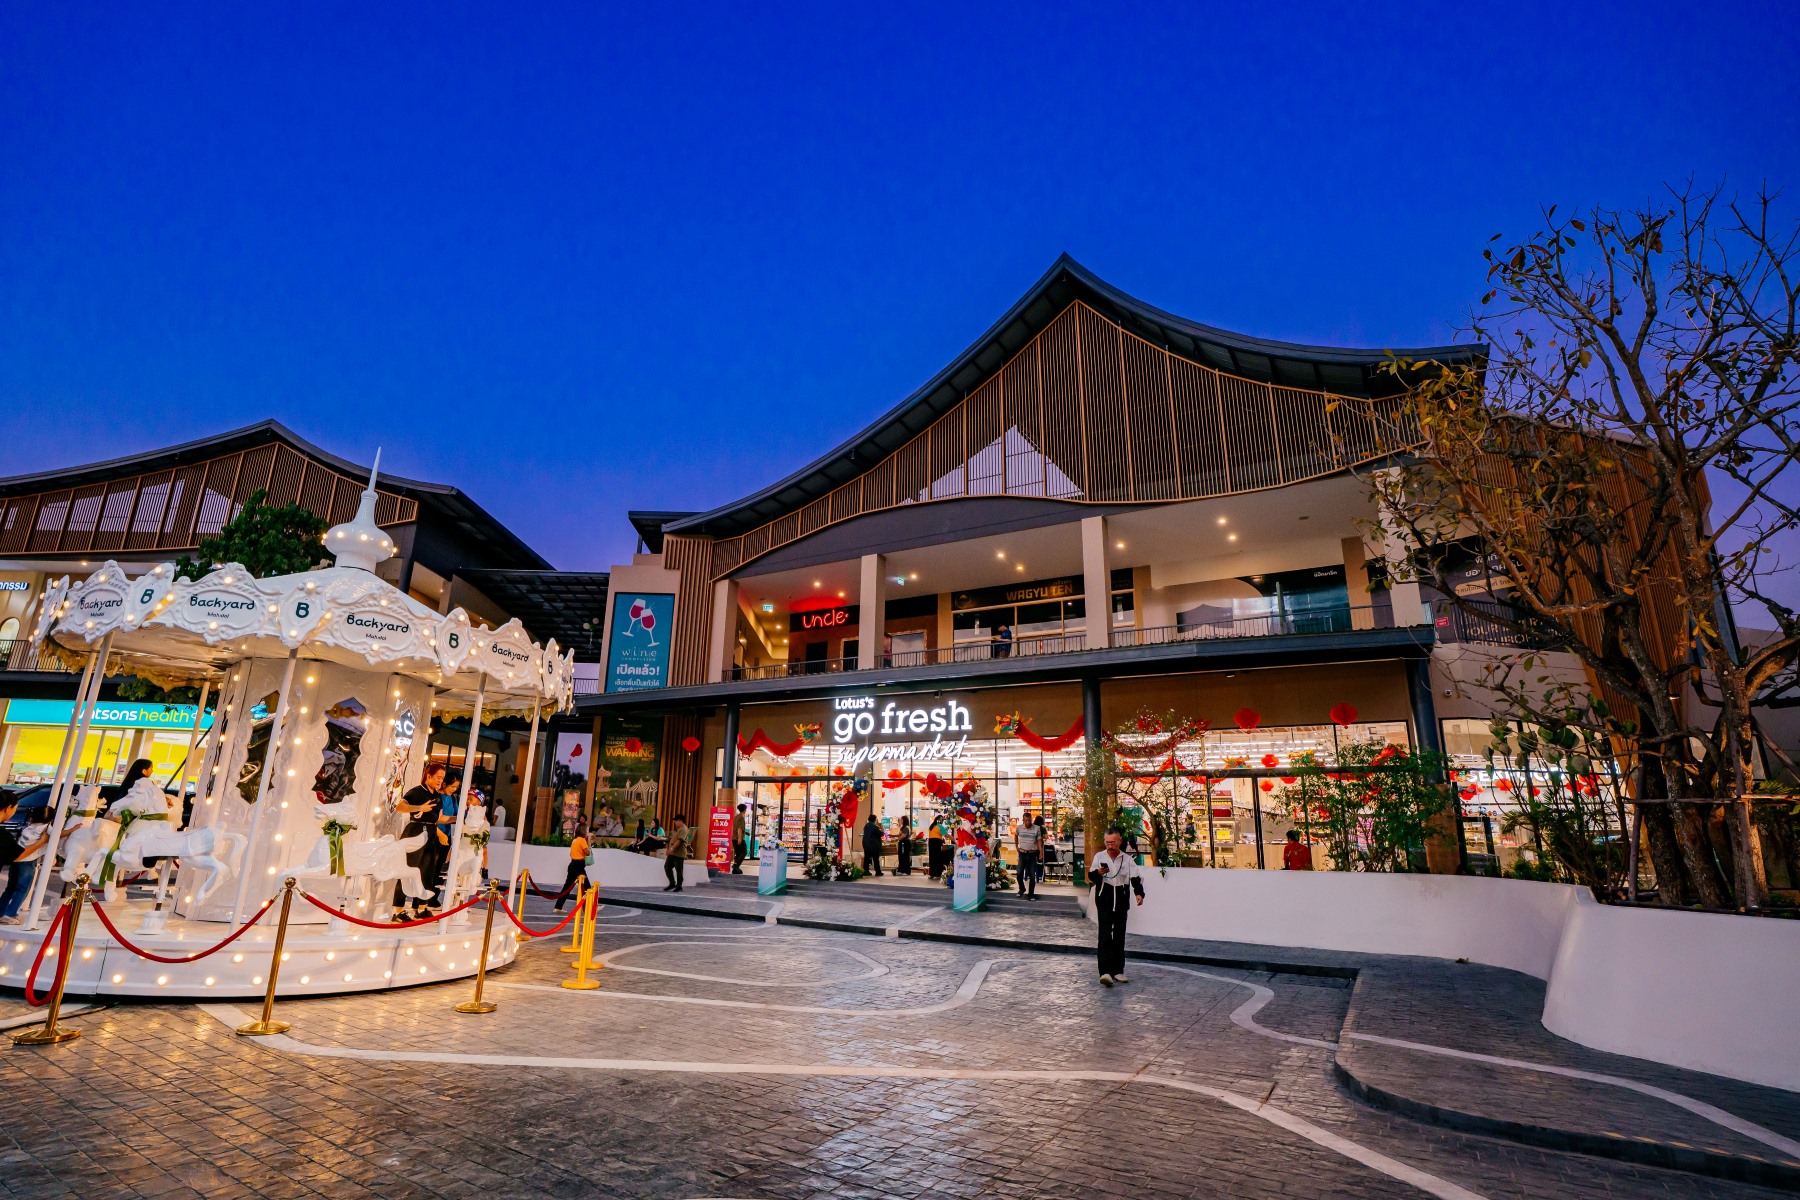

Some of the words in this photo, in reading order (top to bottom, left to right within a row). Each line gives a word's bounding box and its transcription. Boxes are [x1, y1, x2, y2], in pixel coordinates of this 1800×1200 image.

[140, 589, 154, 604] B
[1006, 587, 1048, 601] WAGYU
[1051, 583, 1073, 596] TEN
[80, 597, 123, 611] Backyard
[190, 595, 255, 611] Backyard
[295, 601, 309, 618] B
[346, 614, 409, 633] Backyard
[449, 633, 459, 648] B
[491, 643, 530, 662] Backyard
[547, 660, 553, 674] B
[616, 663, 660, 676] เปิดแล้ว!
[835, 697, 874, 710] Lotus's
[71, 707, 138, 722] tsons
[138, 708, 190, 723] health
[833, 712, 875, 743] go
[881, 700, 972, 734] fresh
